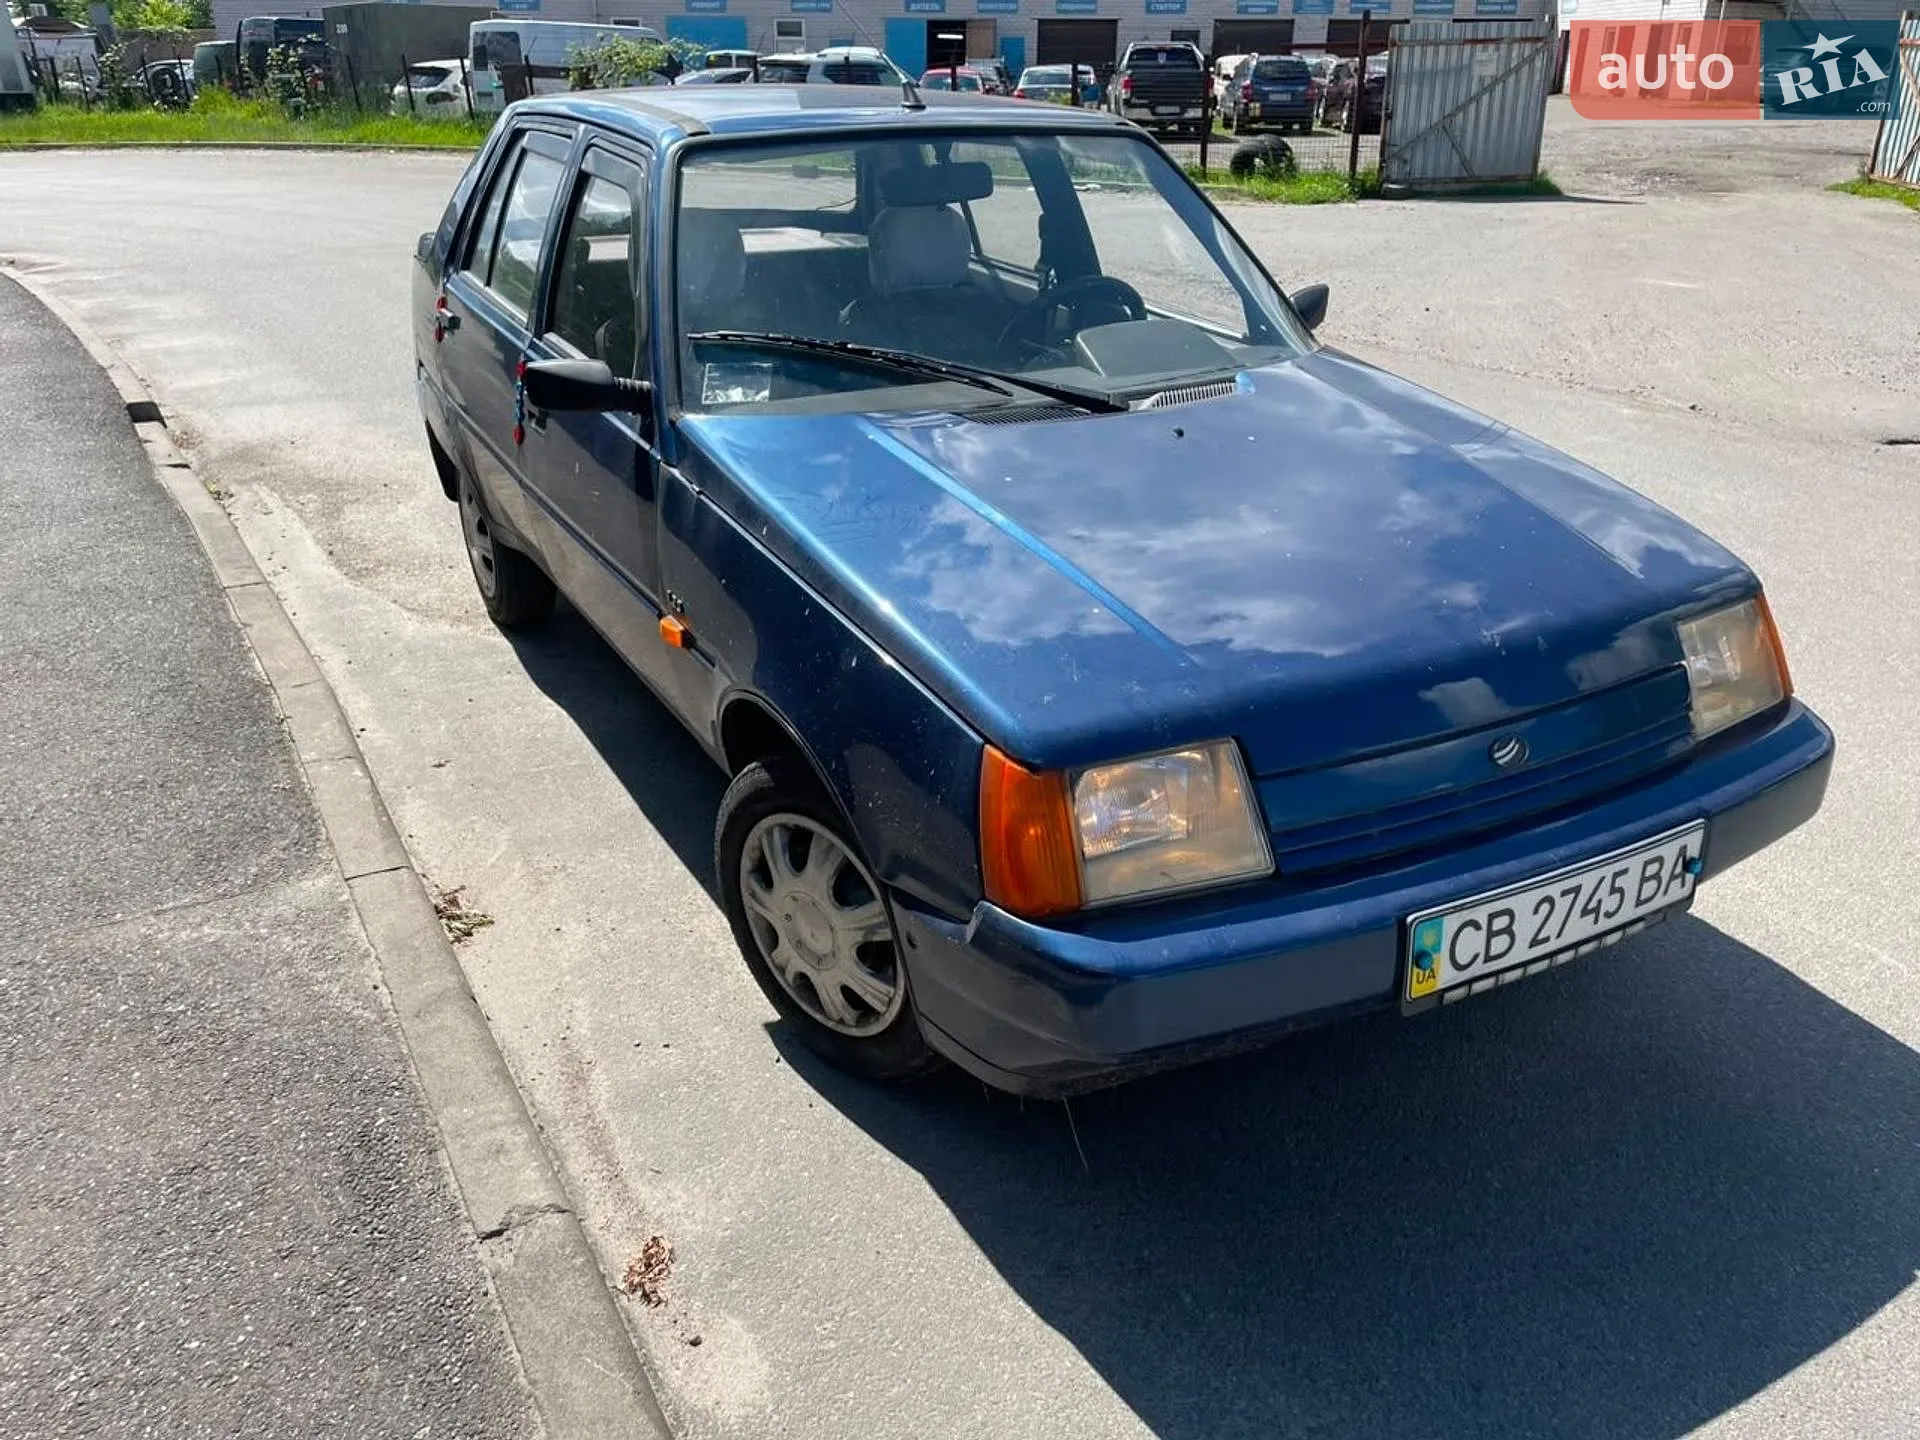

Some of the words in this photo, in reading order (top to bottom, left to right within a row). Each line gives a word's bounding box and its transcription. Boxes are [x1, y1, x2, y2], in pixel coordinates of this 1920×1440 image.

[1449, 908, 1516, 971] CB
[1528, 867, 1630, 949] 2745
[1634, 844, 1687, 909] BA
[1416, 968, 1436, 984] UA
